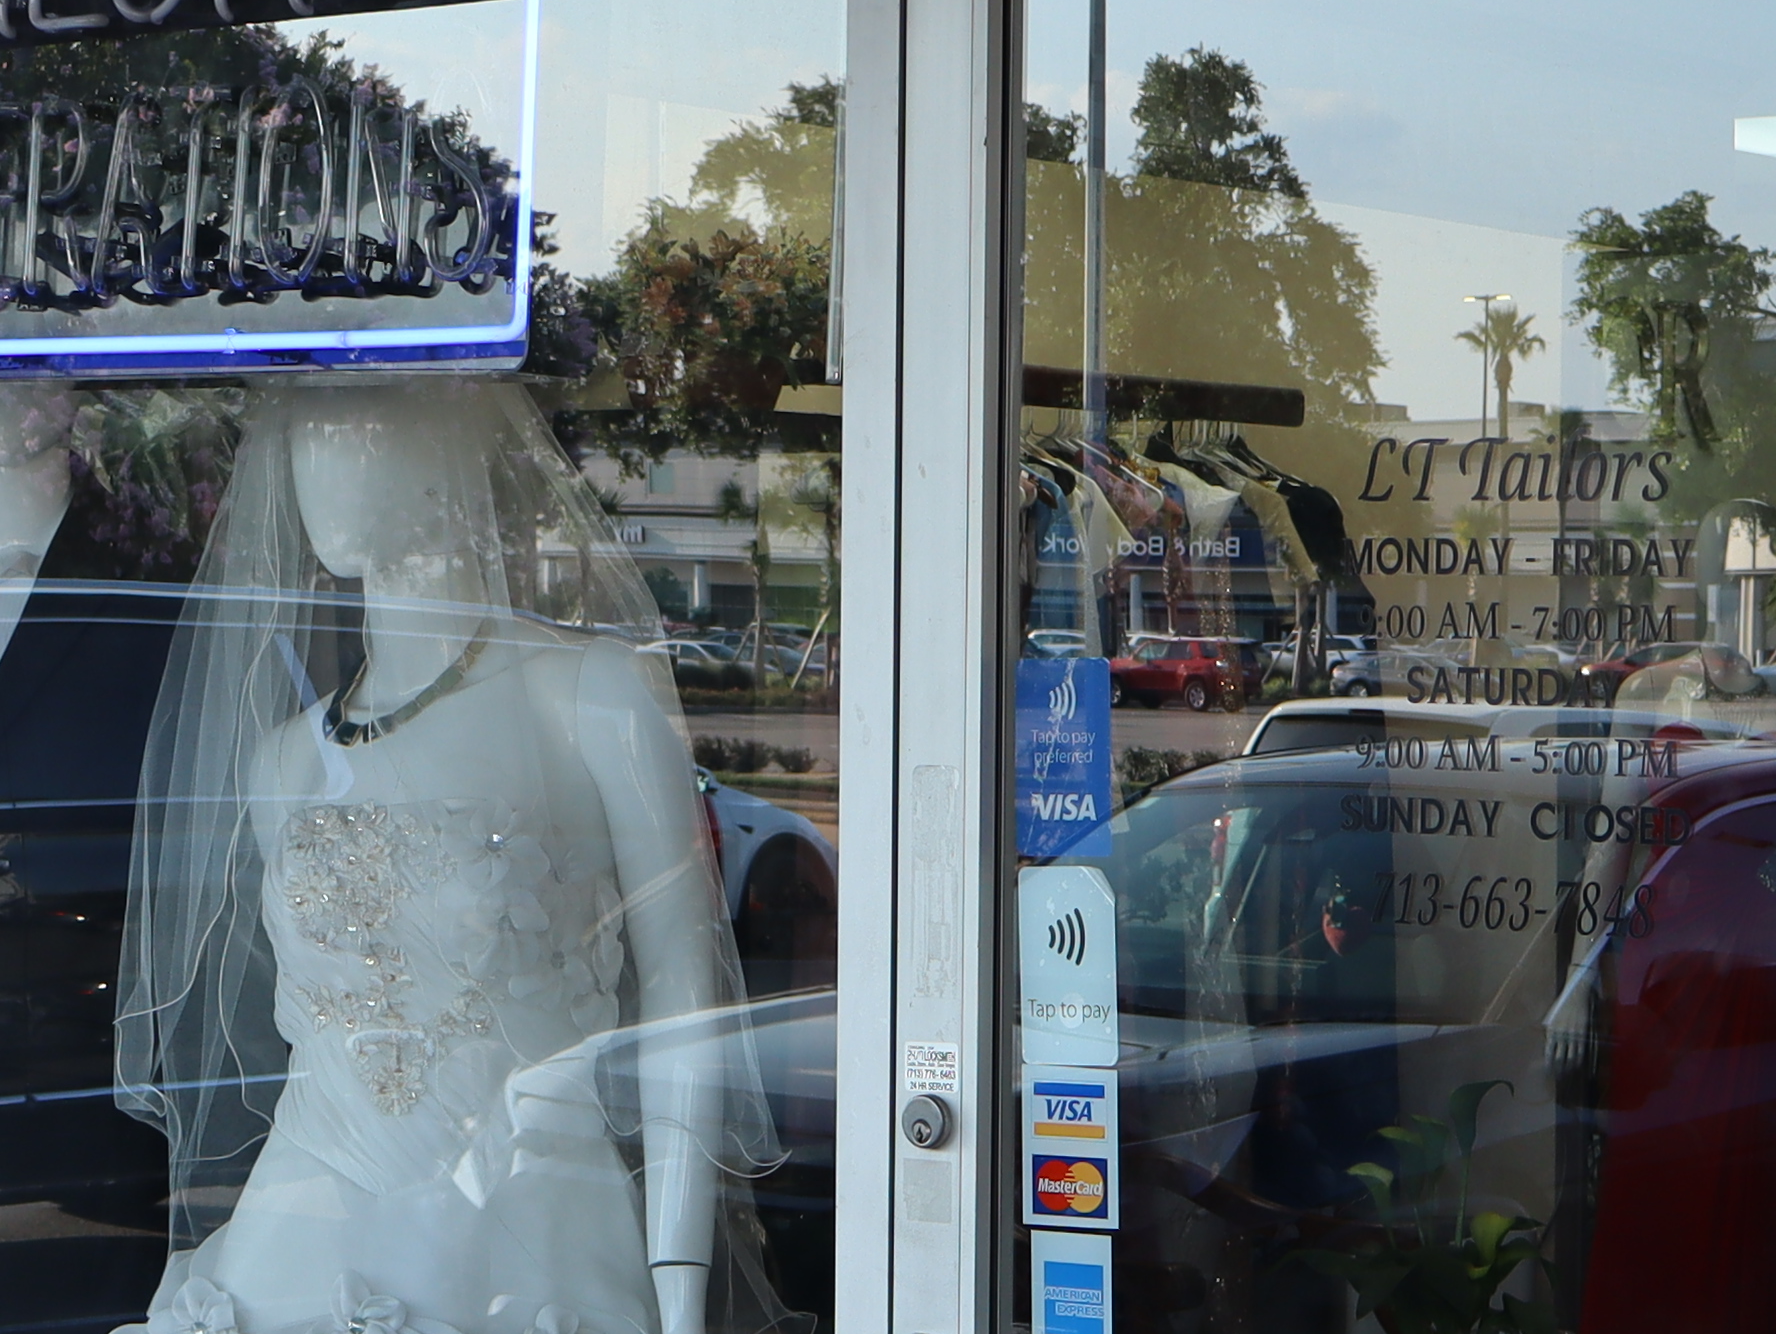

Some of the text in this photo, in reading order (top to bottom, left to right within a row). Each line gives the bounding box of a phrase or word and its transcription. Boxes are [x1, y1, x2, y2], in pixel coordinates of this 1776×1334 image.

[1357, 428, 1673, 503] LT Tailors
[1343, 537, 1516, 575] MONDAY
[1551, 538, 1695, 577] FRIDAY
[1436, 602, 1500, 640] AM
[1531, 606, 1606, 642] 7:00
[1614, 605, 1677, 643] PM
[1406, 666, 1624, 708] SATURDAY
[1030, 729, 1096, 746] Tap to pay
[1034, 748, 1093, 766] preferred
[1354, 734, 1426, 769] 9:00
[1434, 734, 1502, 773] AM
[1531, 737, 1605, 776] 5:00
[1614, 739, 1681, 778] PM
[1031, 793, 1097, 821] VISA
[1339, 793, 1505, 838] SUNDAY
[1371, 871, 1655, 940] 713-663-7848
[1027, 998, 1111, 1024] Tap to pay
[928, 1082, 954, 1091] SERVICE
[1045, 1098, 1093, 1122] VISA
[1037, 1177, 1104, 1197] MasterCard
[1044, 1287, 1101, 1302] AMERICAN
[1056, 1303, 1105, 1318] EXPRESS
